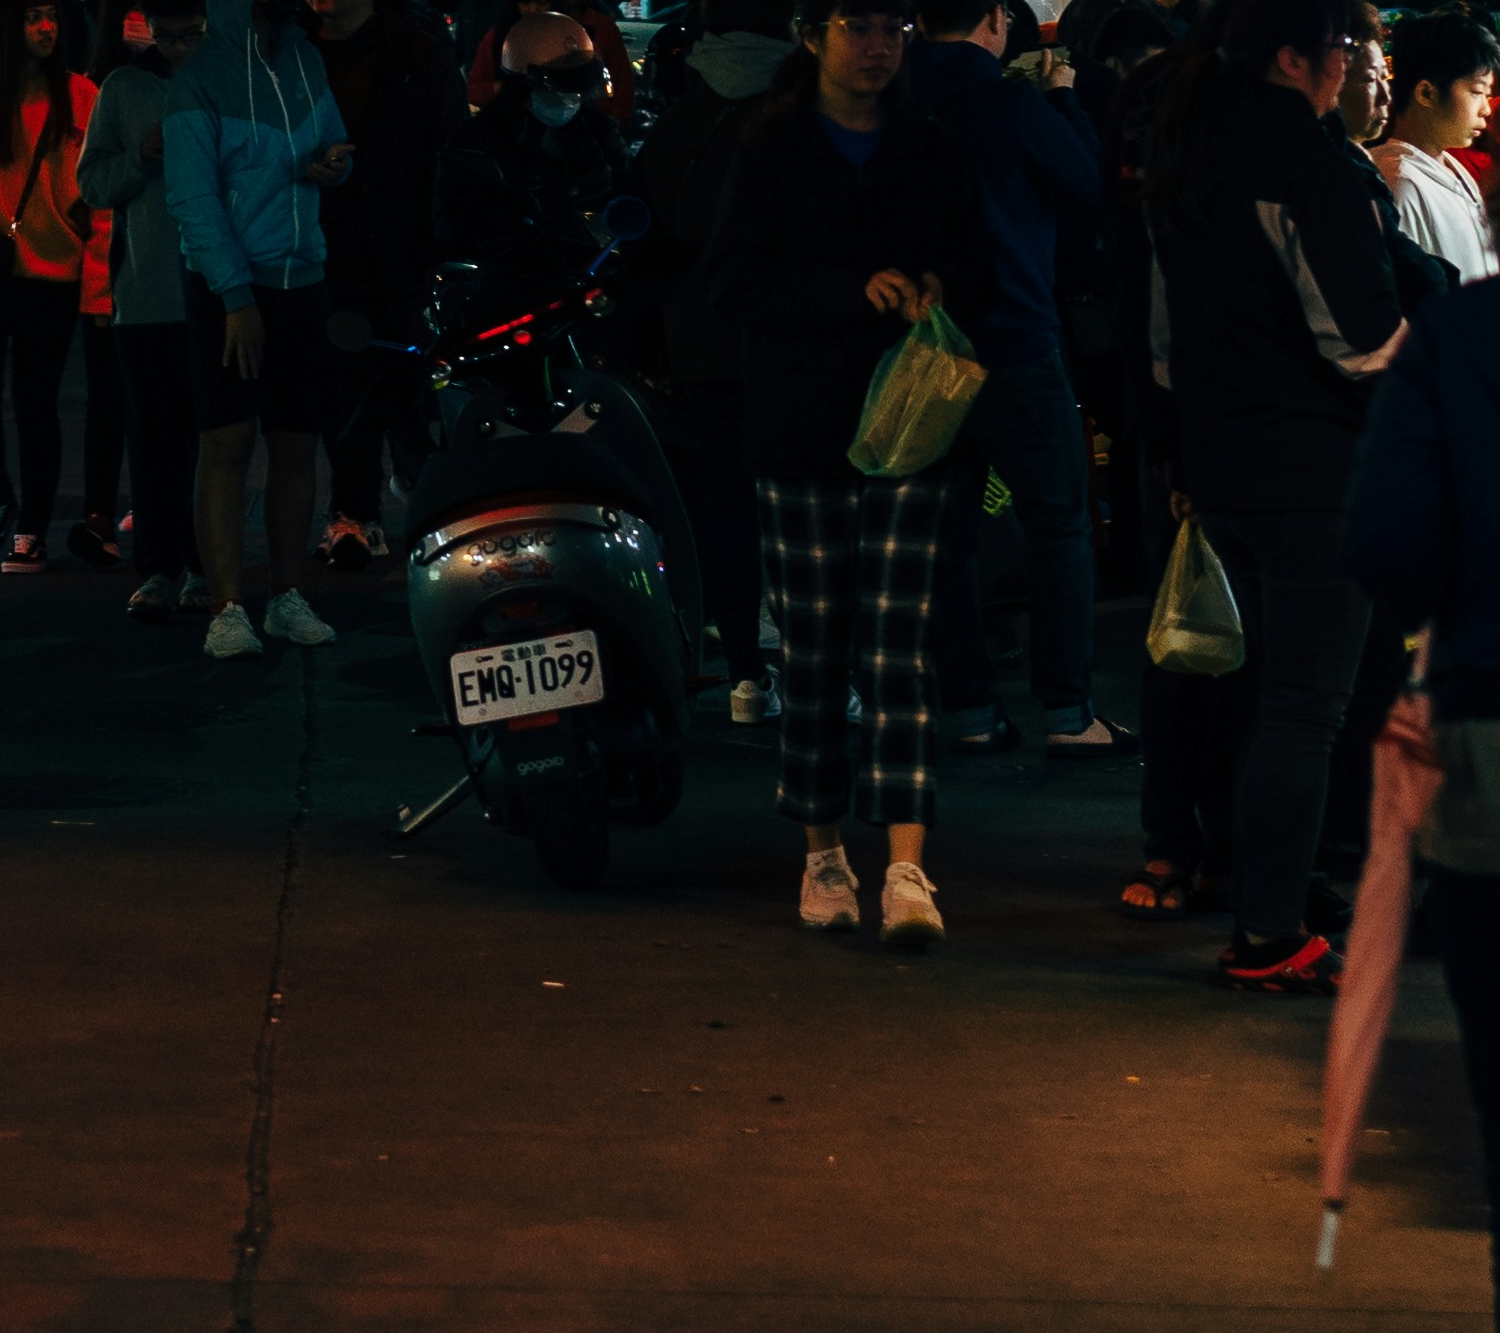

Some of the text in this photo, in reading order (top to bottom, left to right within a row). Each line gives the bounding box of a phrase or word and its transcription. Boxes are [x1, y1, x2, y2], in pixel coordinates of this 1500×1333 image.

[500, 643, 547, 663] 電動車
[516, 754, 565, 778] gogoro
